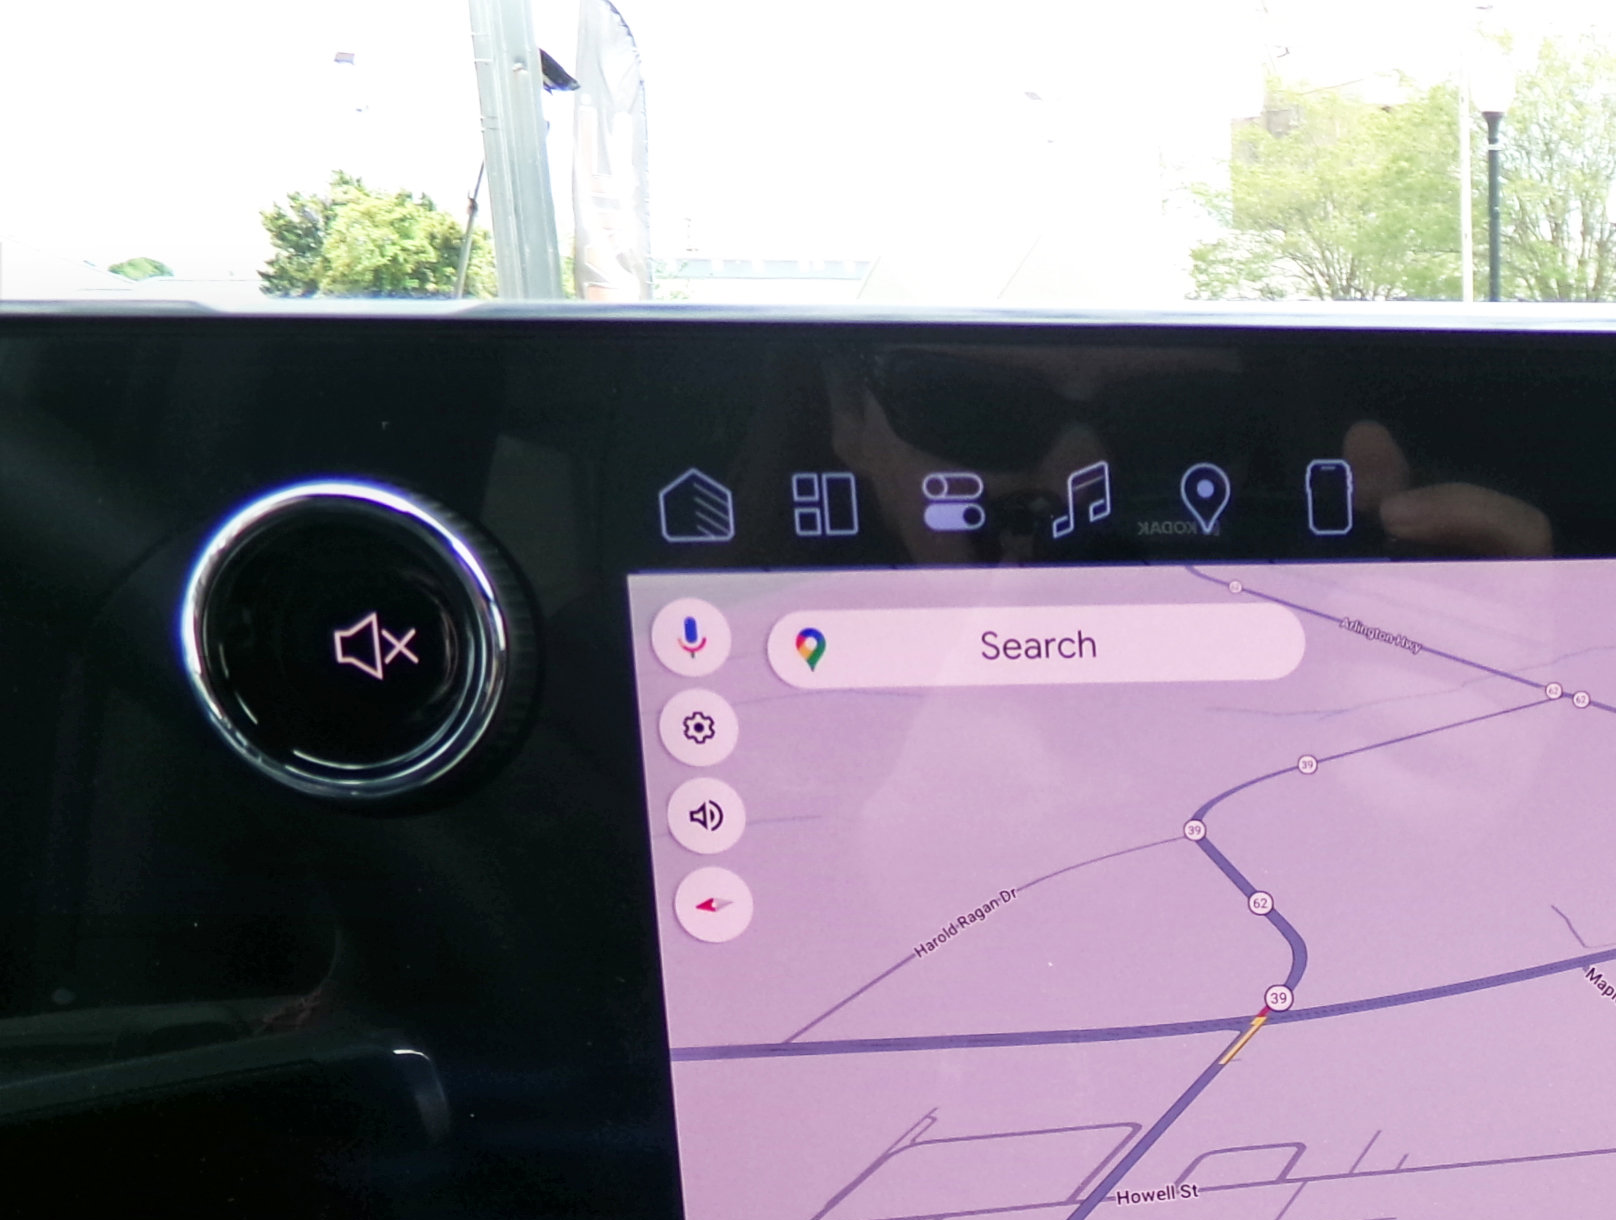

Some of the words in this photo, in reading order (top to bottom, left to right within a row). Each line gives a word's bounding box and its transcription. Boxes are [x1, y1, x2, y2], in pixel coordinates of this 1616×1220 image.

[1340, 617, 1394, 645] Arlington
[1398, 636, 1422, 654] Hwy
[981, 631, 1097, 660] Search
[1302, 759, 1314, 768] 39
[1187, 825, 1201, 836] 39
[1253, 898, 1268, 909] 62
[913, 923, 960, 960] Harold
[956, 897, 1001, 931] Ragan
[999, 886, 1018, 904] Dr
[1271, 993, 1288, 1004] 39
[1116, 1186, 1174, 1206] Howell
[1179, 1184, 1198, 1199] St
